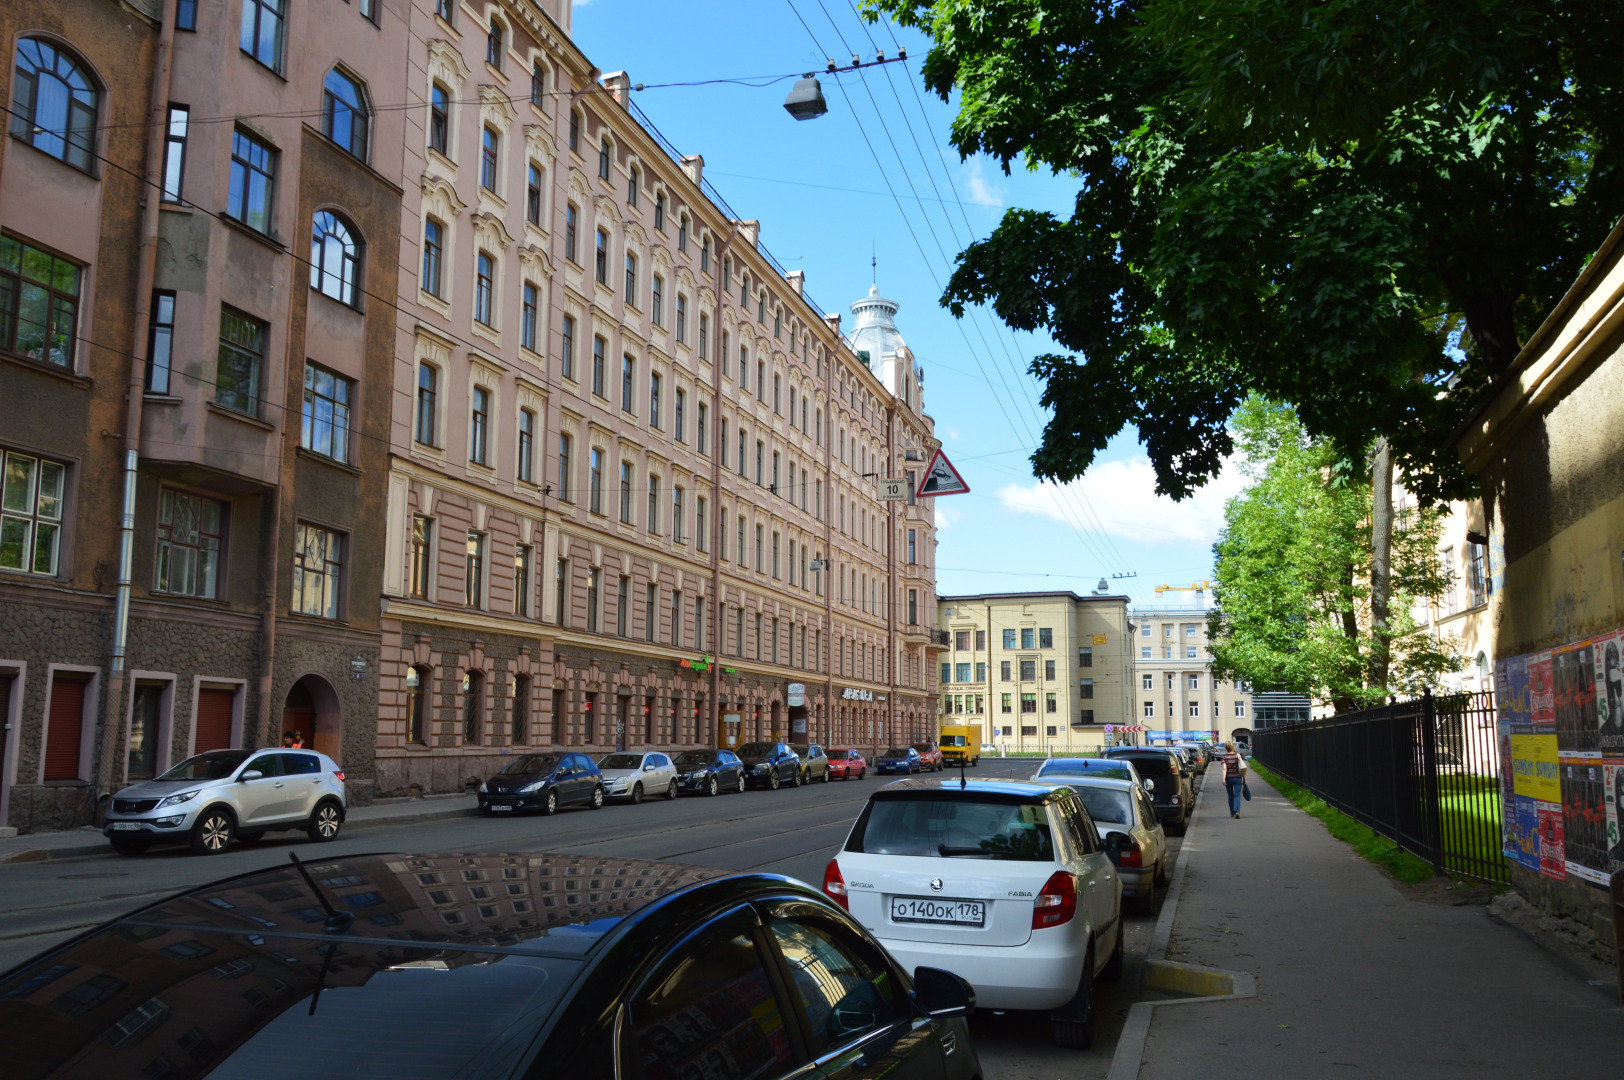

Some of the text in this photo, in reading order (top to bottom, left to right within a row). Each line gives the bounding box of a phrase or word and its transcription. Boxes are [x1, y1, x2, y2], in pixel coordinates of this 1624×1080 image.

[887, 485, 898, 494] 10
[1595, 644, 1601, 663] 2
[1605, 766, 1611, 785] 2
[957, 903, 979, 916] 178
